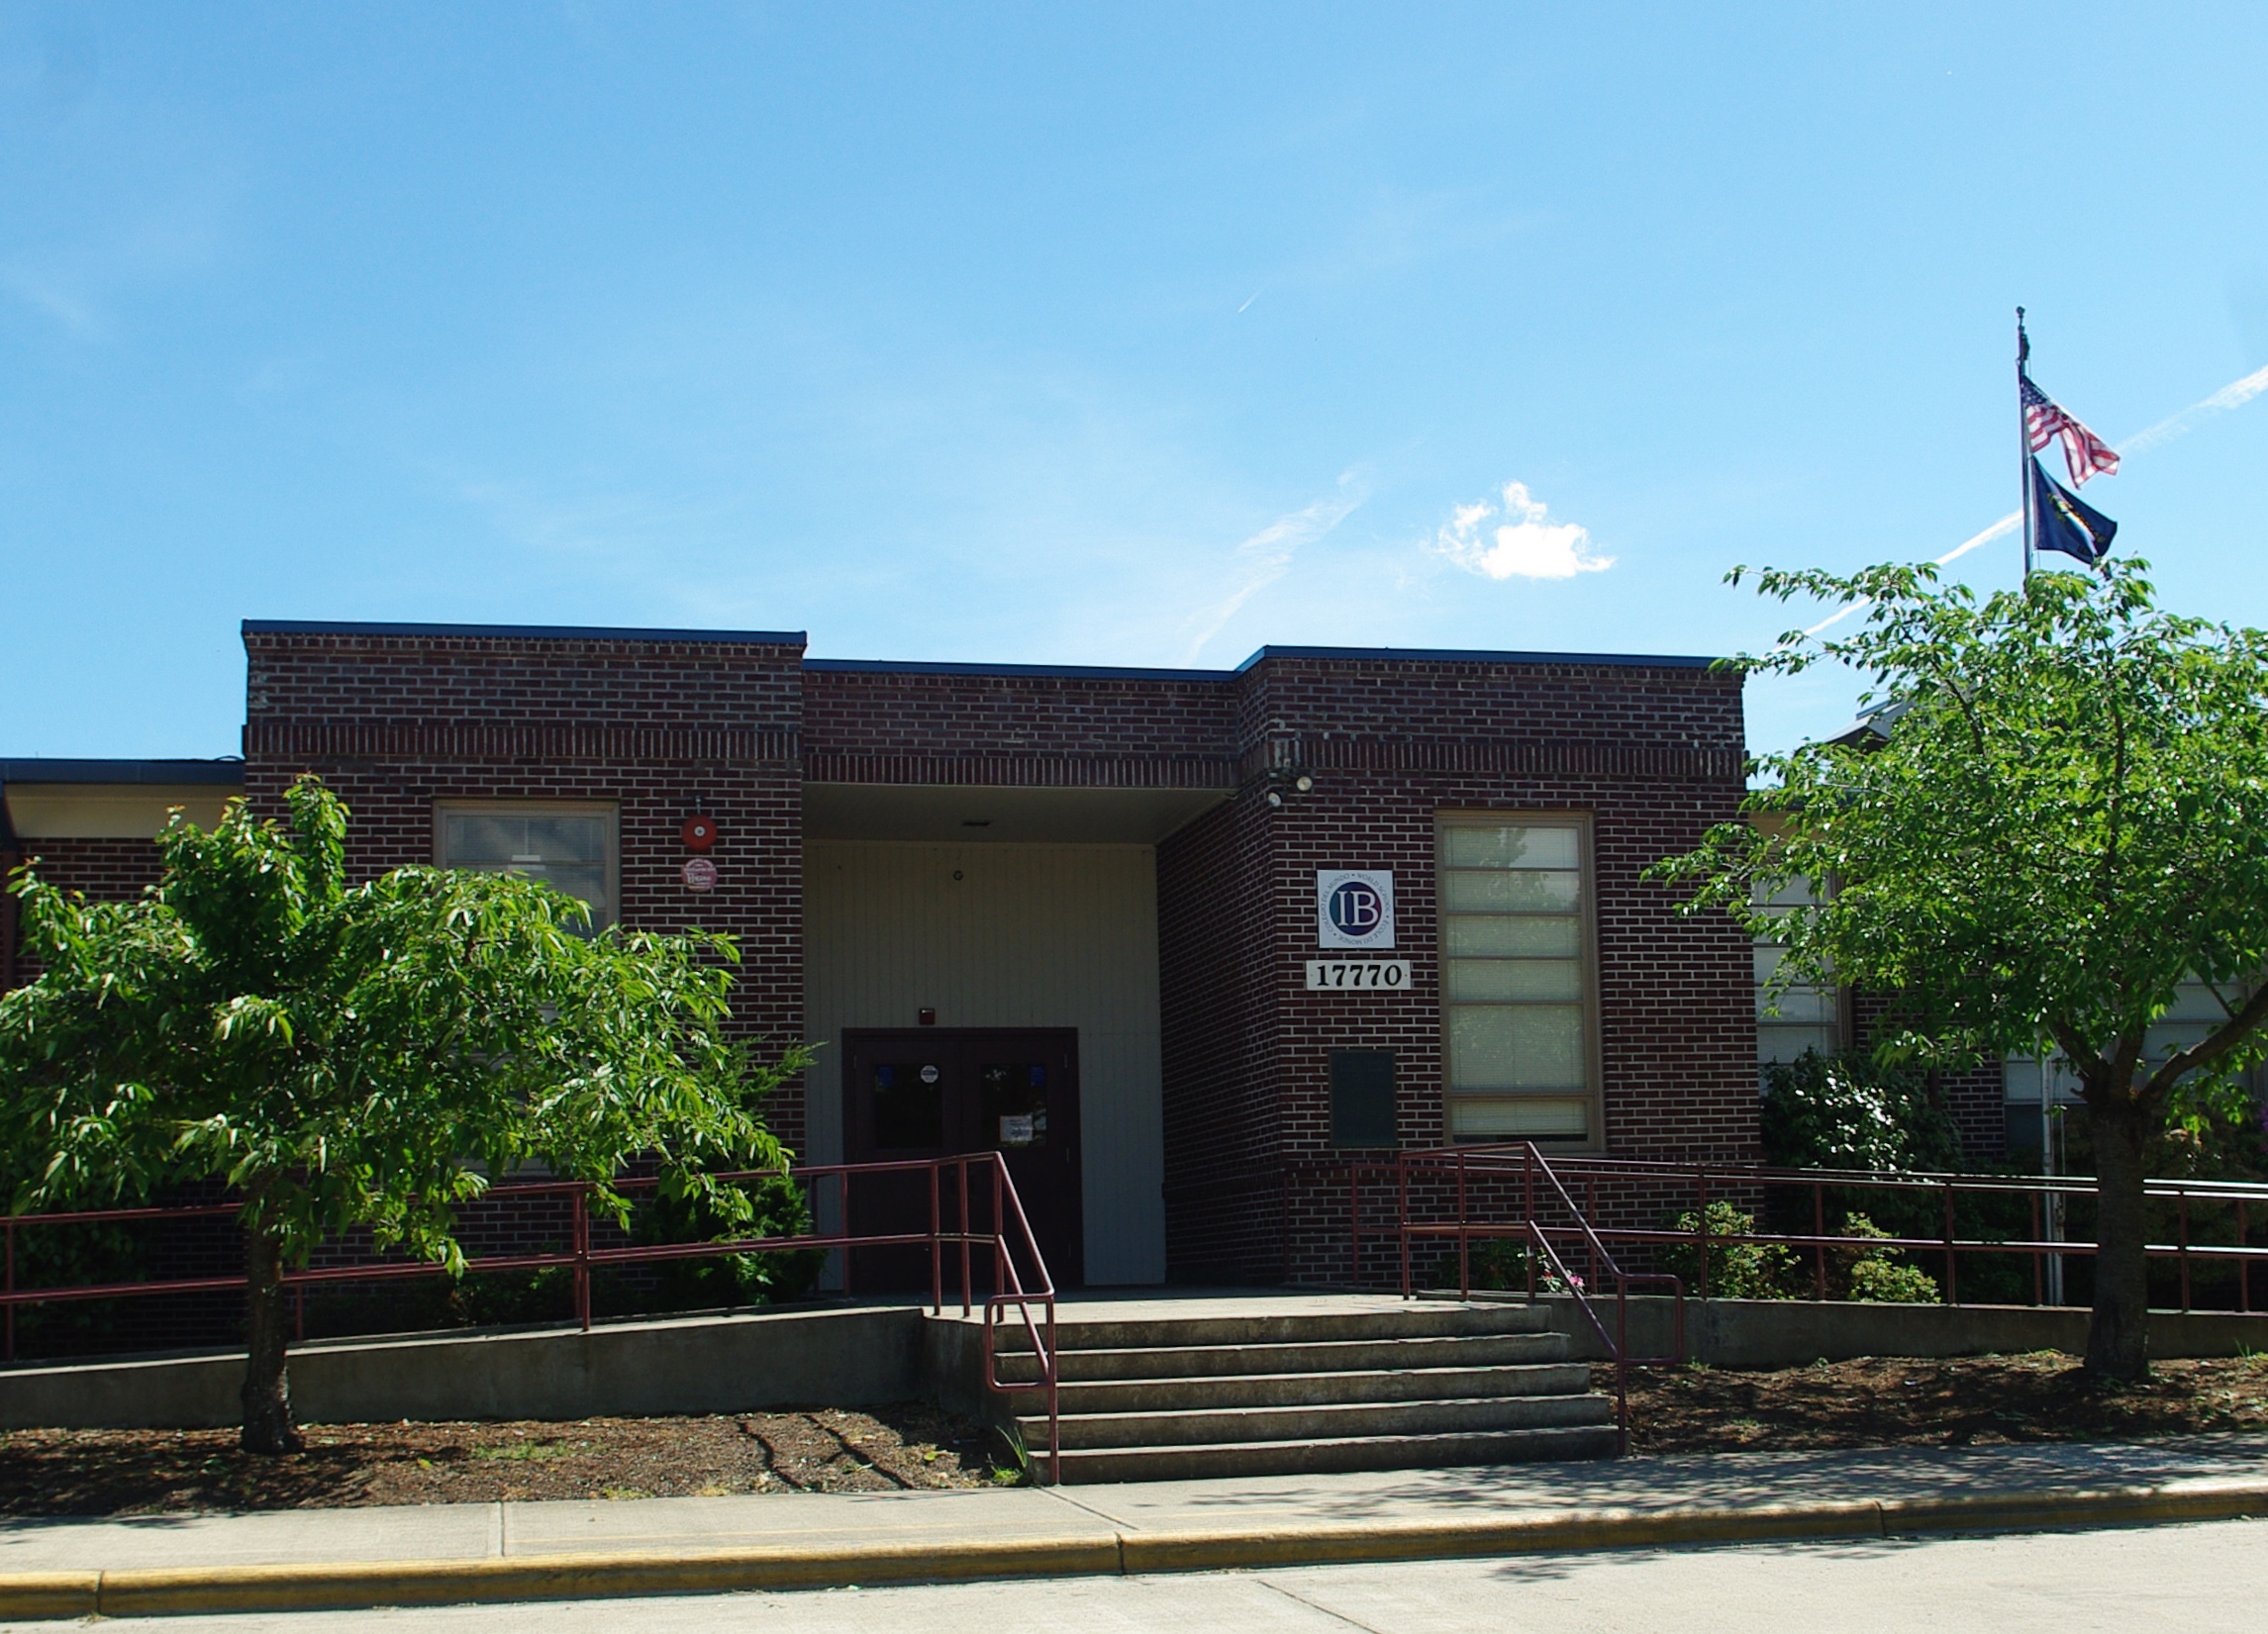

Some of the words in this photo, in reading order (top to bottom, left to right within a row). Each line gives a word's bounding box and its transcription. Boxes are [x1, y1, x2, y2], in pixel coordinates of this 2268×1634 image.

[1327, 873, 1349, 890] MUNDO
[1356, 873, 1379, 887] WORLD
[1336, 891, 1379, 926] IB
[1317, 964, 1402, 987] 17770
